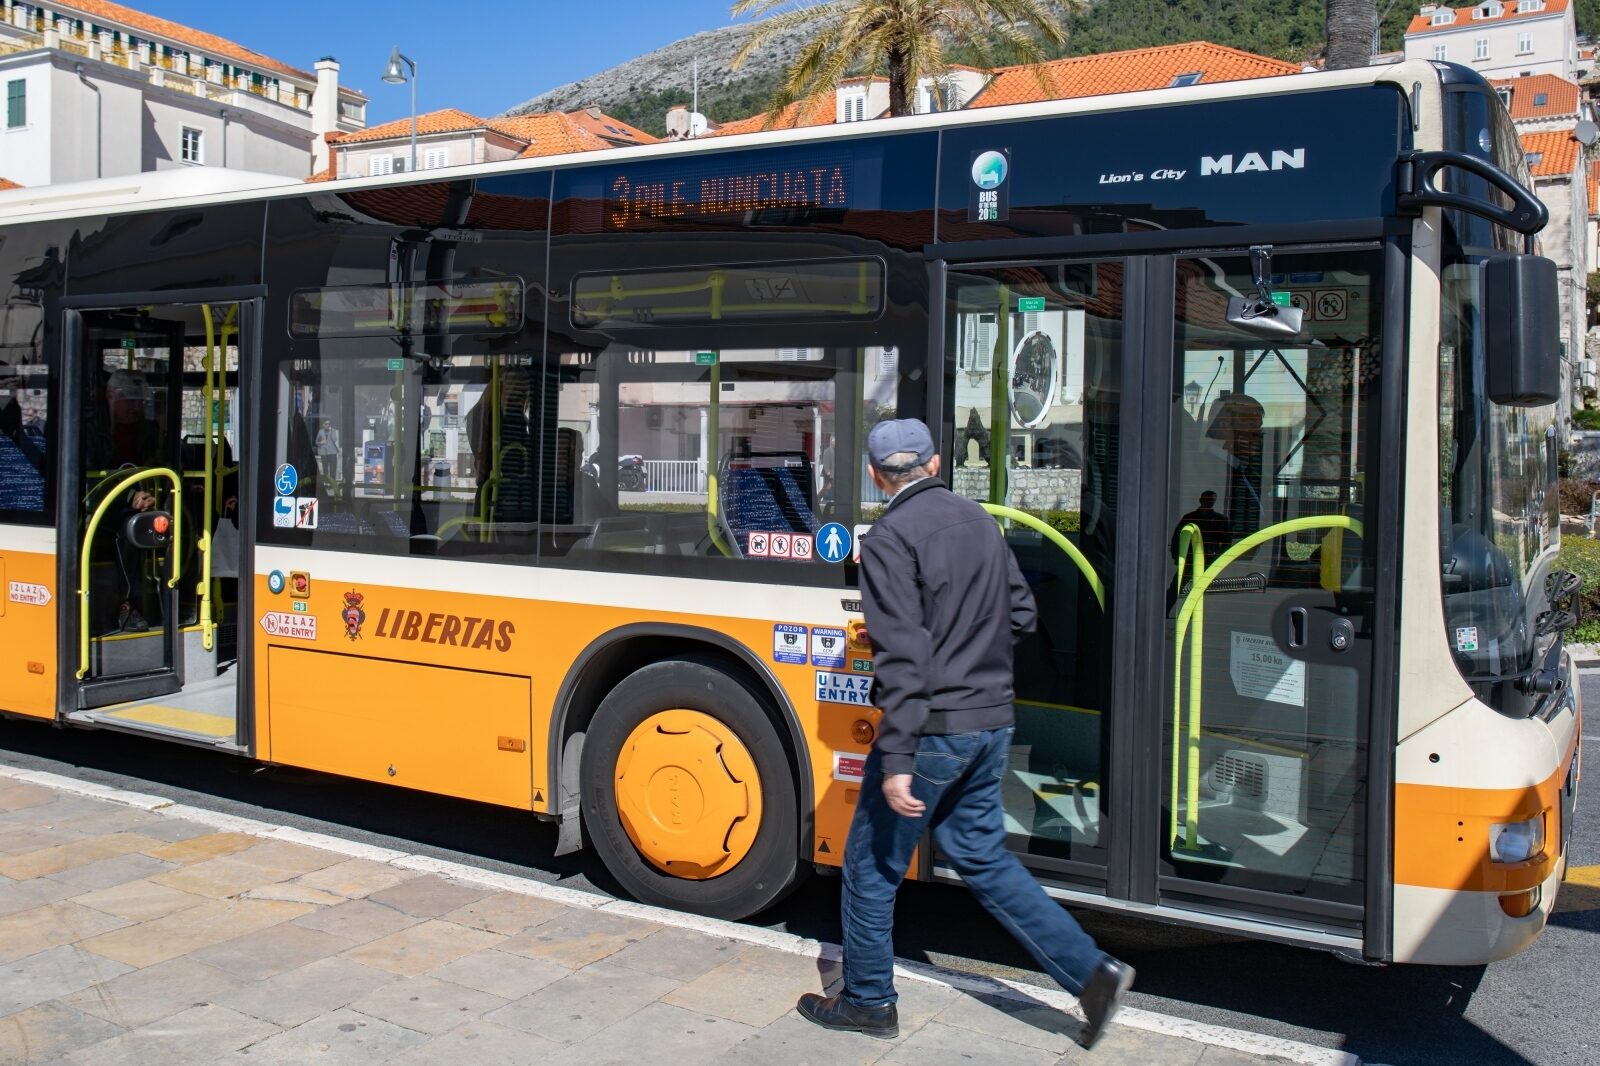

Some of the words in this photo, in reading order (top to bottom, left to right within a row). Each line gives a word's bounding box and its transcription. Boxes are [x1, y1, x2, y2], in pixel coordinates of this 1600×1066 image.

[1200, 148, 1305, 176] MAN
[1099, 172, 1144, 184] Lion's
[1150, 169, 1187, 180] City
[612, 176, 630, 227] 3
[979, 191, 998, 202] BUS
[978, 208, 998, 220] 2015
[10, 584, 37, 593] IZLAZ
[20, 595, 37, 603] ENTRY
[278, 615, 315, 627] IZLAZ
[278, 626, 289, 635] NO
[291, 628, 314, 638] ENTRY
[375, 607, 516, 652] LIBERTAS
[778, 625, 804, 633] POZOR
[814, 628, 843, 637] WARNING
[1251, 652, 1273, 664] 15,00
[1273, 656, 1283, 665] kn
[818, 675, 869, 691] ULAZ
[818, 688, 869, 703] ENTRY
